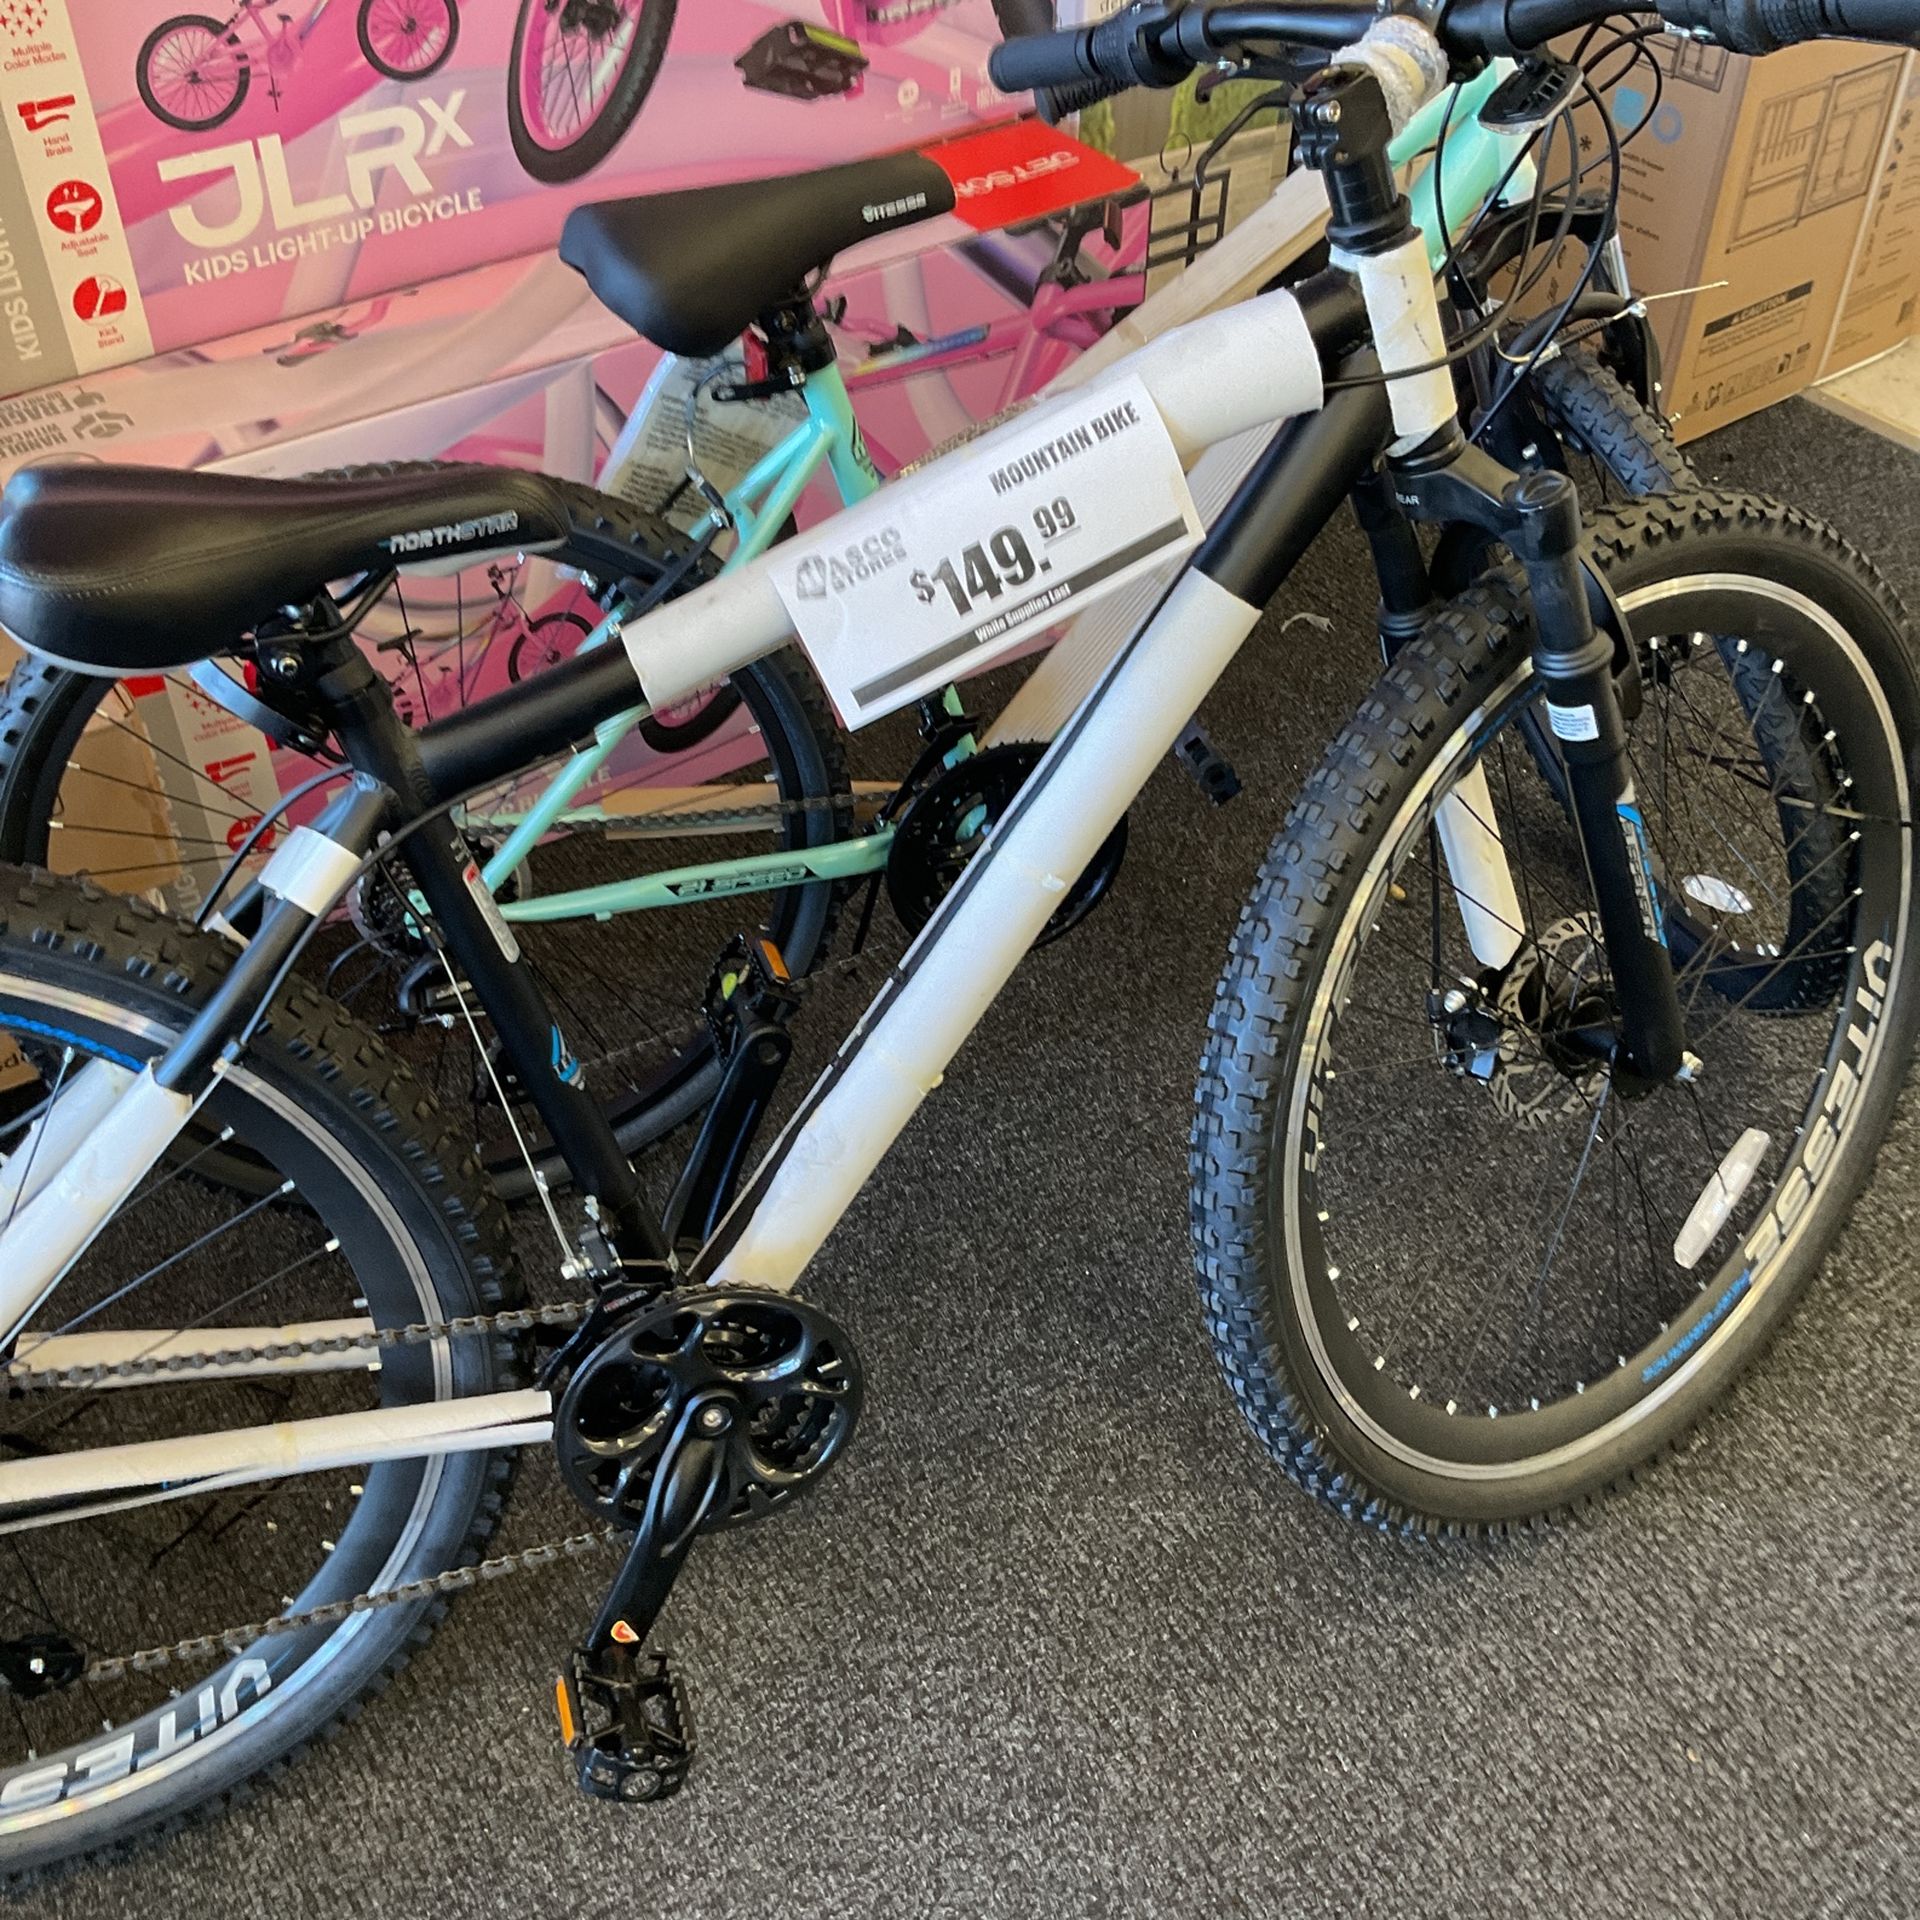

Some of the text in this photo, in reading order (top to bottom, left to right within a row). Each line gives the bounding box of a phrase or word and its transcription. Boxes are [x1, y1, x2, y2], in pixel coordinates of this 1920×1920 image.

[4, 51, 67, 71] Color Modes
[12, 42, 53, 57] Multiple
[43, 133, 70, 146] Hand
[60, 232, 109, 251] Adjustable
[183, 187, 484, 286] KIDS LIGHT-UP BICYCLE
[5, 296, 42, 361] KIDS
[988, 400, 1141, 496] MOUNTAIN BIKE
[974, 616, 1006, 643] While
